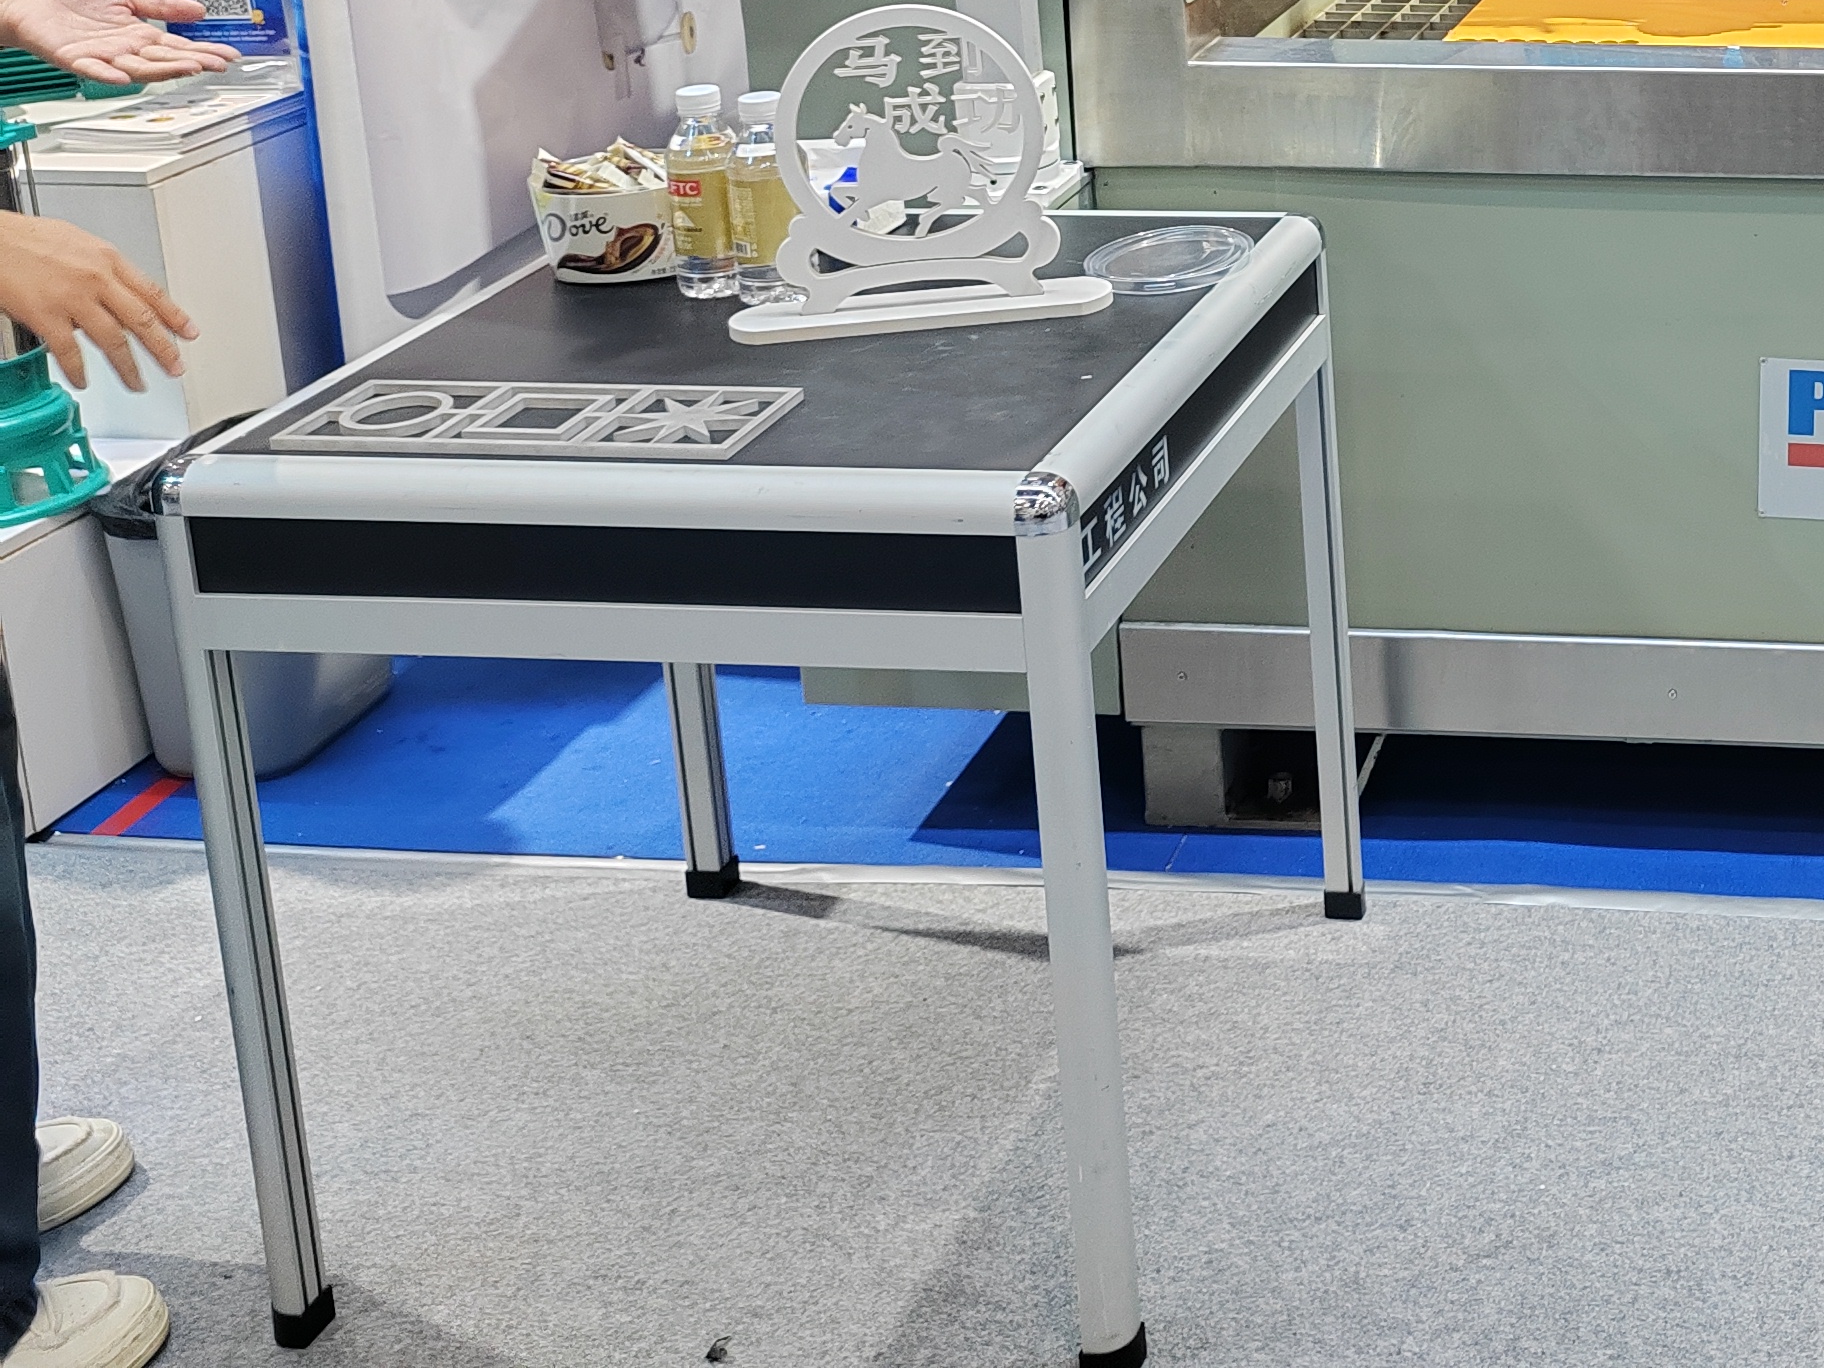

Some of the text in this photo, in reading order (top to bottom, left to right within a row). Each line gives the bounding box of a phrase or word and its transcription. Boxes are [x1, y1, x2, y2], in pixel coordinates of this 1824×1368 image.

[543, 212, 615, 243] Dove
[1081, 434, 1170, 570] 工程公司
